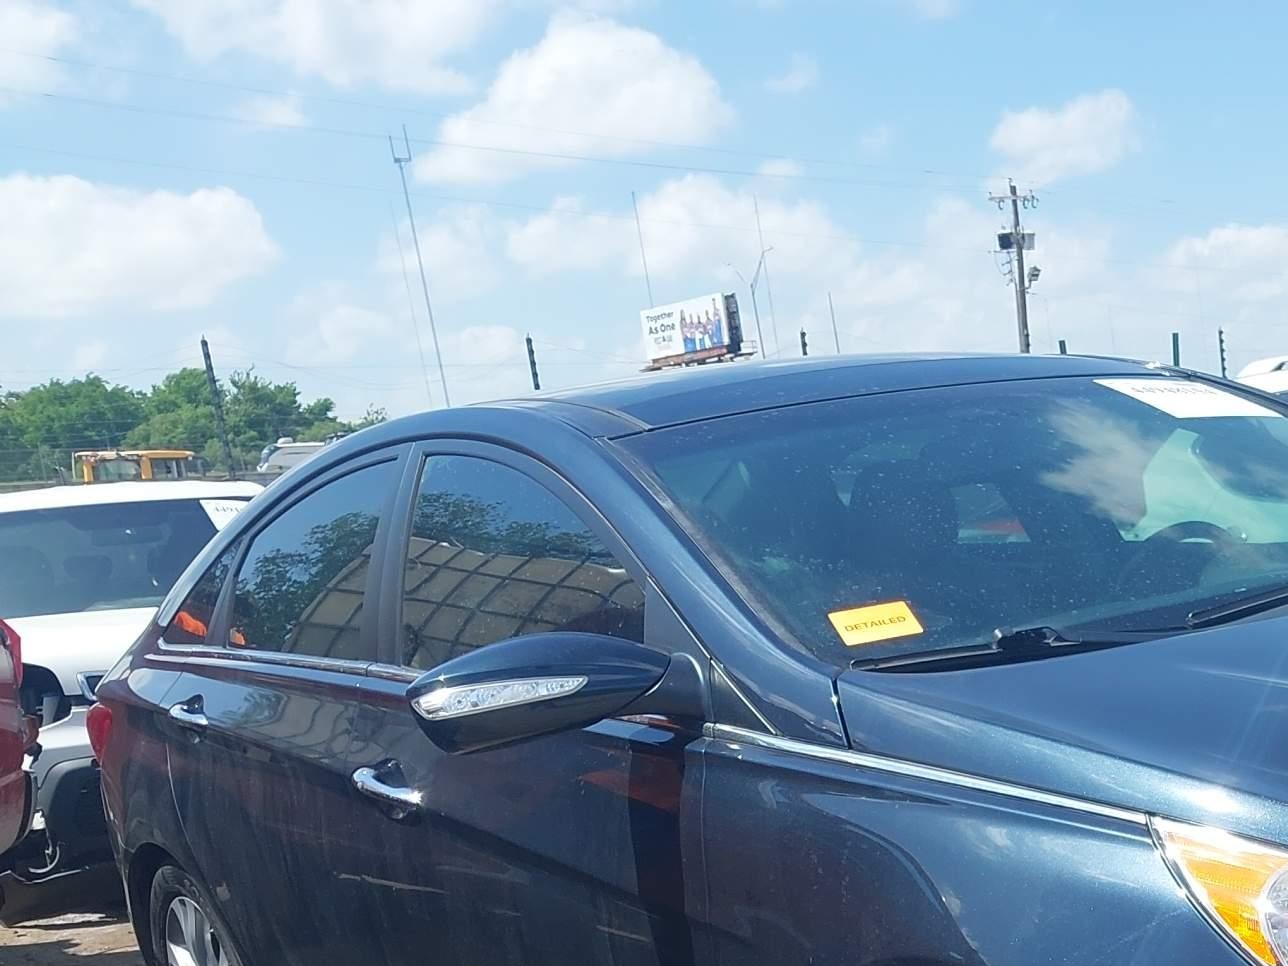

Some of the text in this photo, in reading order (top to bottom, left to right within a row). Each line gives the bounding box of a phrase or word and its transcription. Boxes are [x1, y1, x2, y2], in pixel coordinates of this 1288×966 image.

[646, 311, 674, 324] Together
[648, 322, 676, 335] As One
[844, 615, 907, 632] DETAILED
